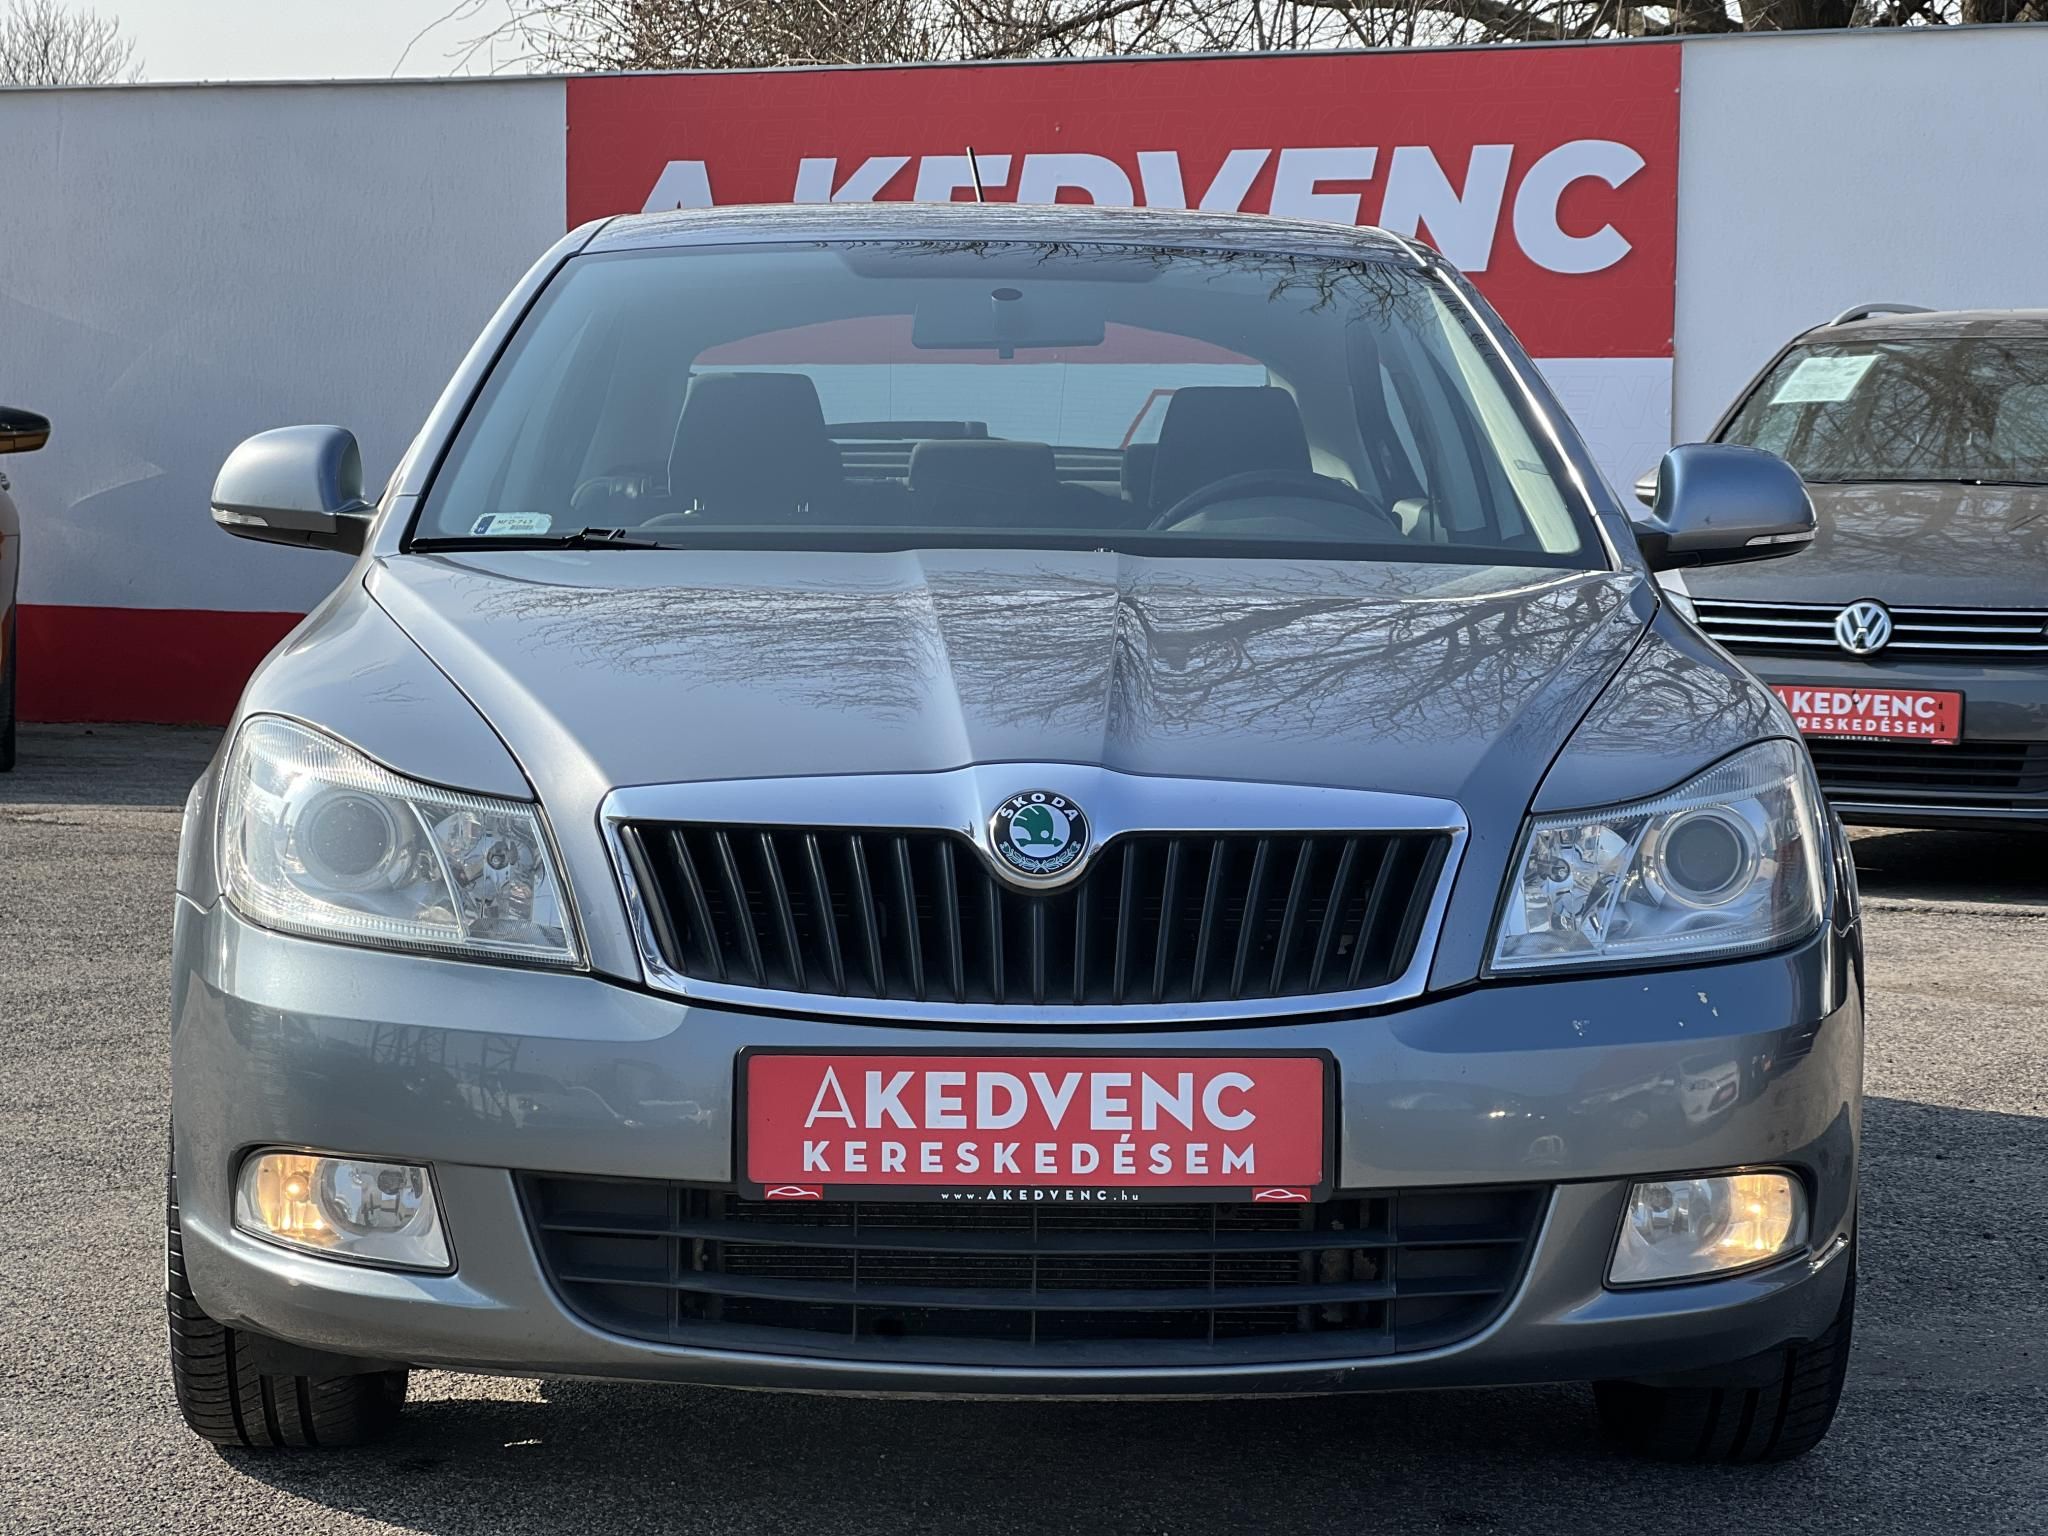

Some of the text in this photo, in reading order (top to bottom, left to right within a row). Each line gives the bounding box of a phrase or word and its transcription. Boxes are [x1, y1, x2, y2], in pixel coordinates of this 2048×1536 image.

[1797, 716, 1935, 734] RESKEDÉSEM
[803, 1133, 1256, 1174] KERESKEDÉSEM
[941, 1189, 1139, 1201] www.AKEDVENC.hu
